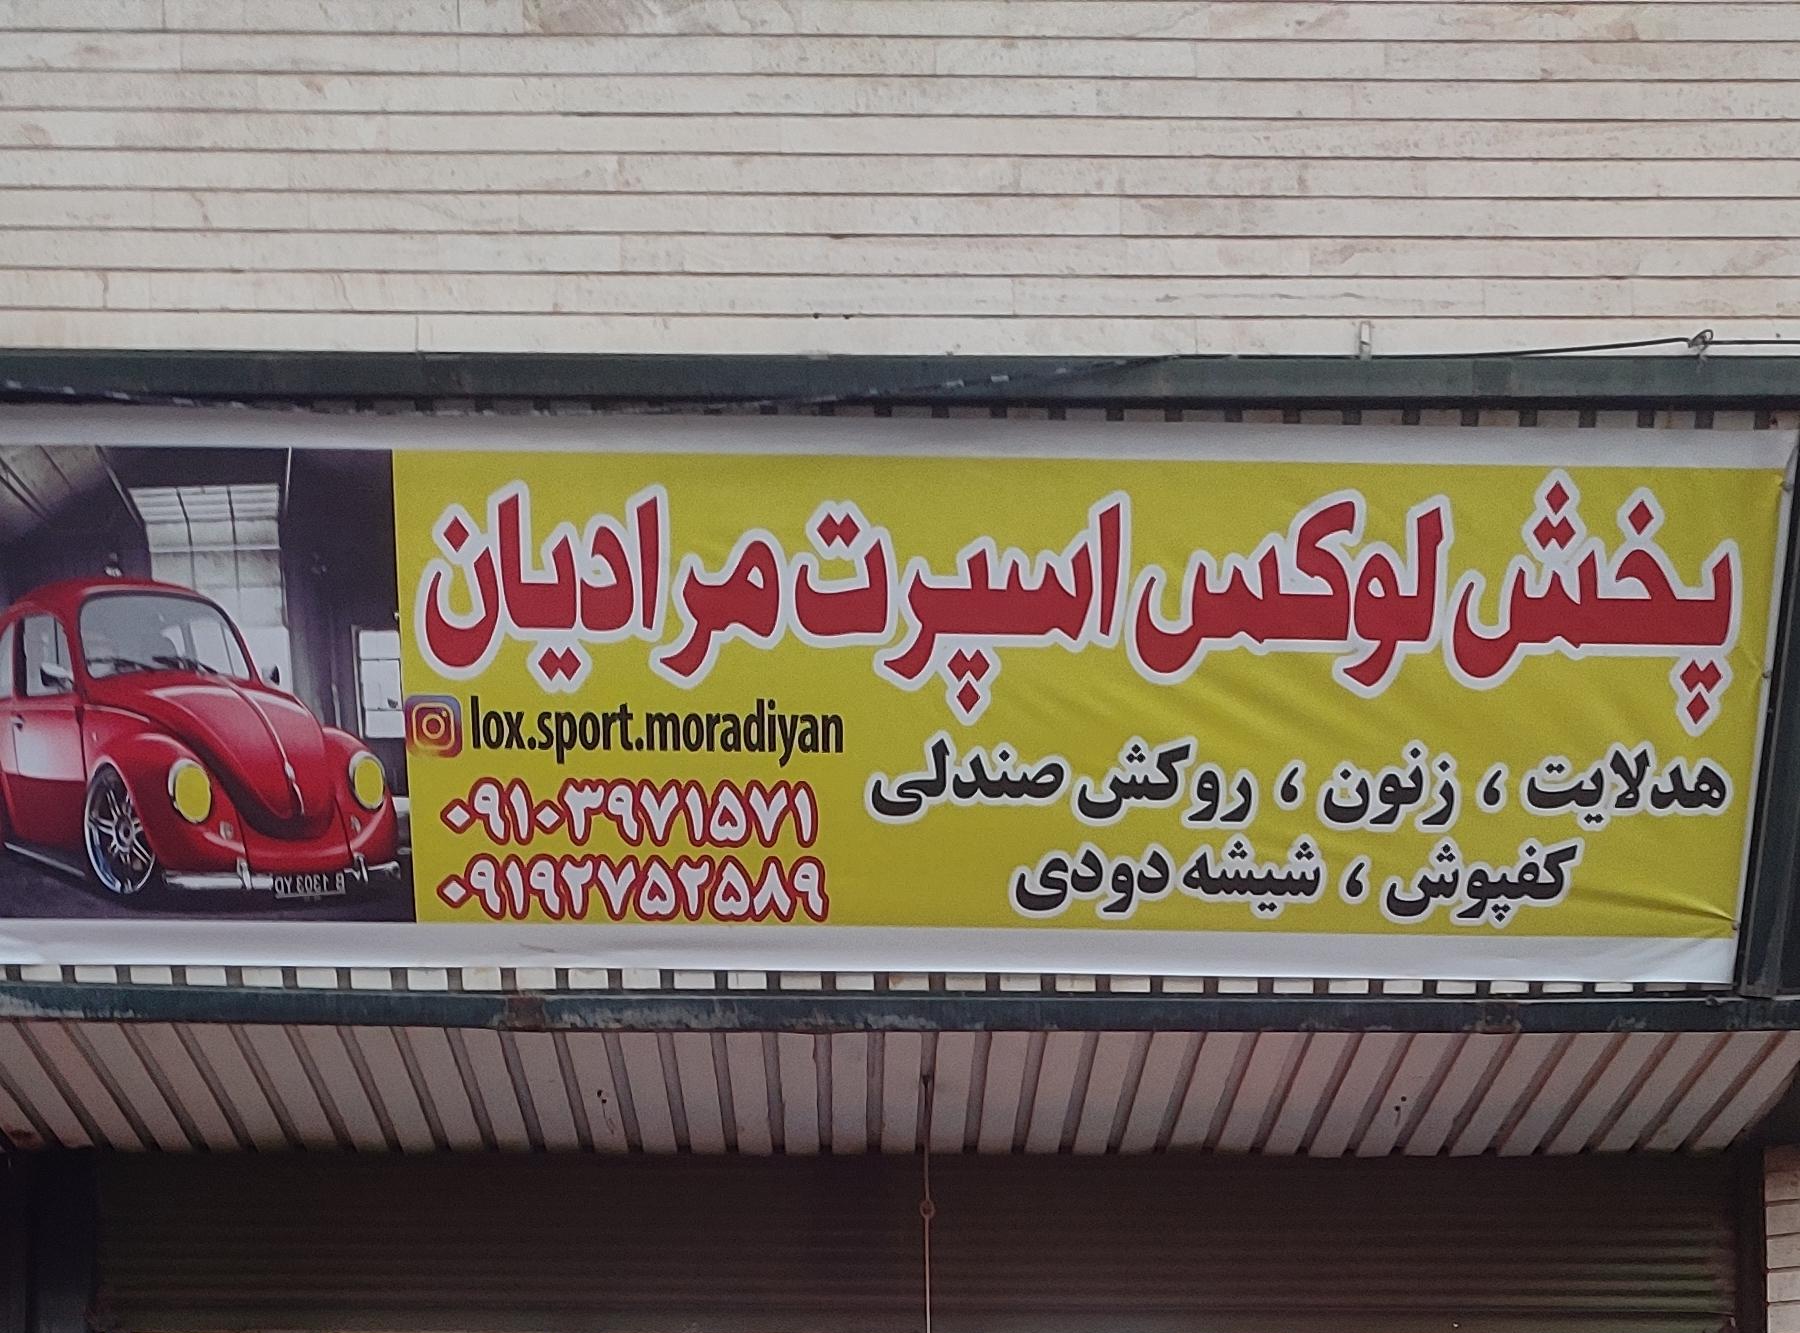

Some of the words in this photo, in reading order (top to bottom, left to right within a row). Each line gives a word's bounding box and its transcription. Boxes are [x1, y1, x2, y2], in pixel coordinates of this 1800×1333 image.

[424, 492, 781, 682] مرادیان
[797, 500, 1124, 713] اسپرت
[1134, 500, 1446, 687] لوکس
[1455, 480, 1733, 725] پخش
[470, 695, 844, 766] lox.sport.moradiyan
[447, 780, 817, 846] ۰۹۱۰۳۹۷۱۵۷۱
[873, 738, 1066, 820] صندلی
[1077, 740, 1254, 823] روکش
[1322, 746, 1455, 828] زنون
[1527, 746, 1728, 826] هدلایت
[439, 856, 828, 921] ۰۹۱۹۲۷۵۲۵۸۹
[1014, 846, 1170, 917] دودی
[1188, 840, 1323, 915] شیشه
[1386, 841, 1583, 925] کفپوش
